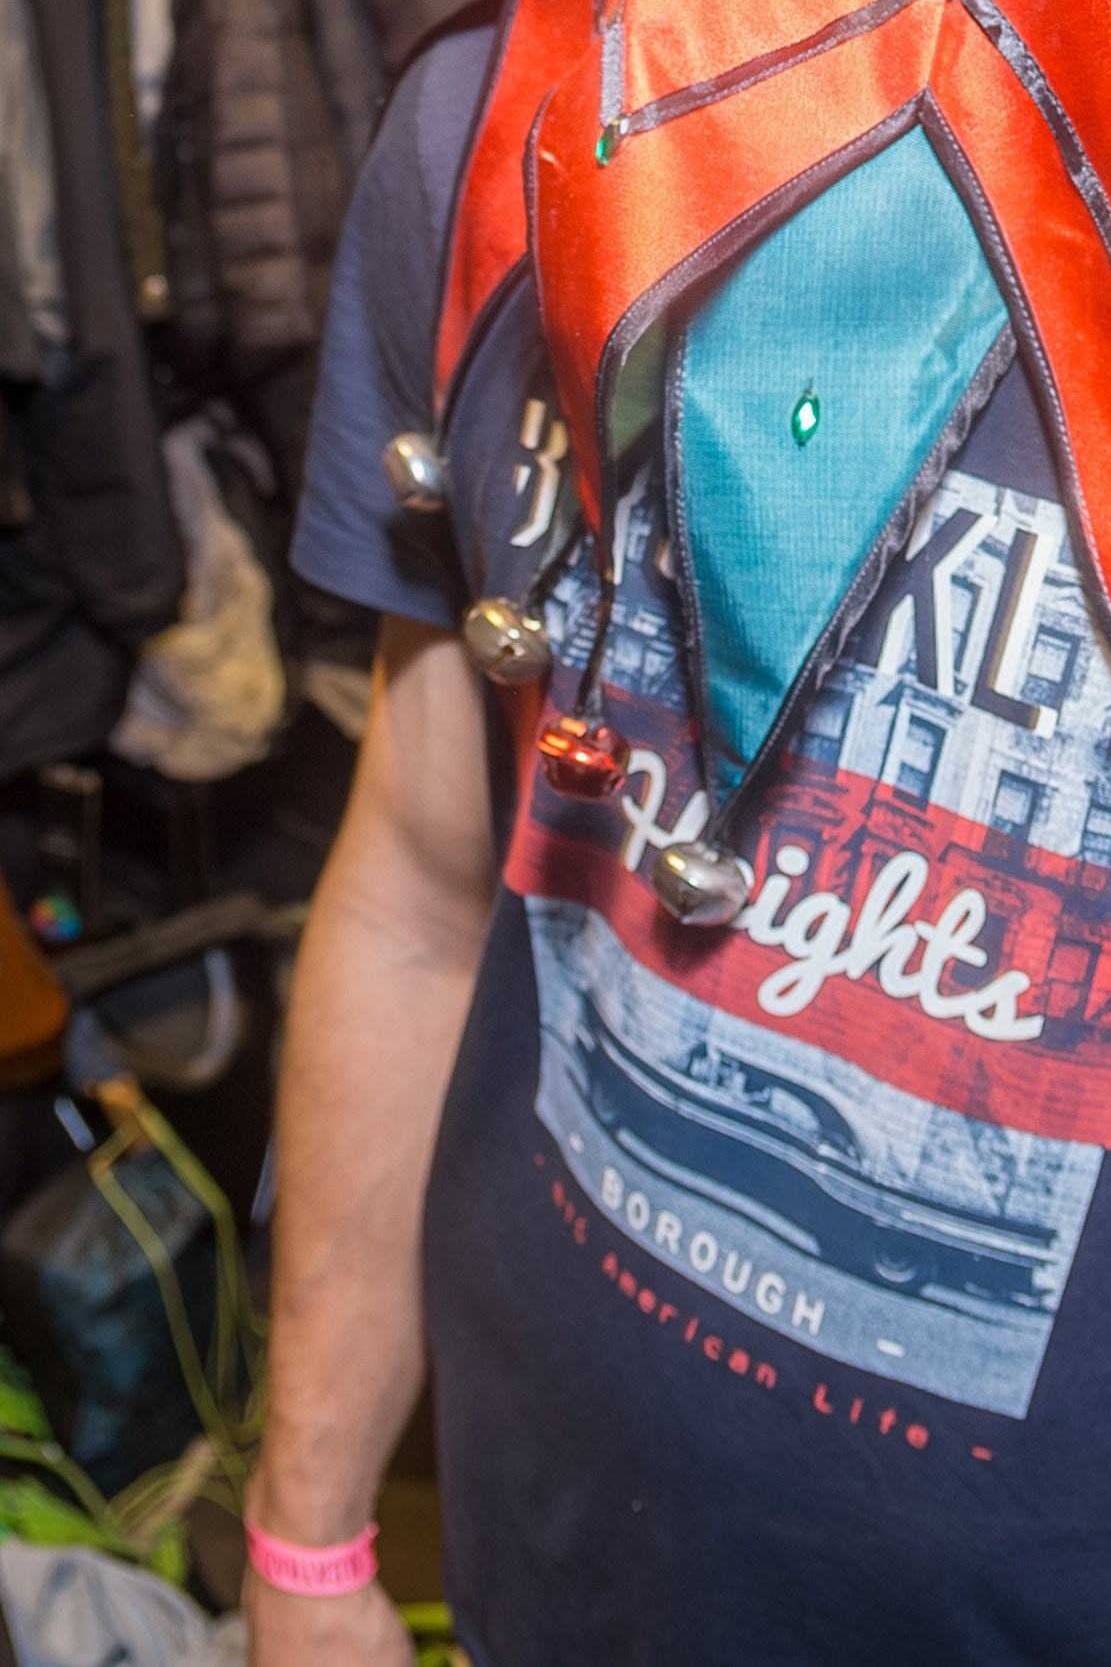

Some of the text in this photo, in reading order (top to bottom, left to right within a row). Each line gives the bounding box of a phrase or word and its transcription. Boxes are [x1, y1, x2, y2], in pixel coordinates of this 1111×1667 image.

[619, 748, 1045, 1041] Hights
[602, 1166, 826, 1336] BOROUGH
[602, 1252, 930, 1451] American Life
